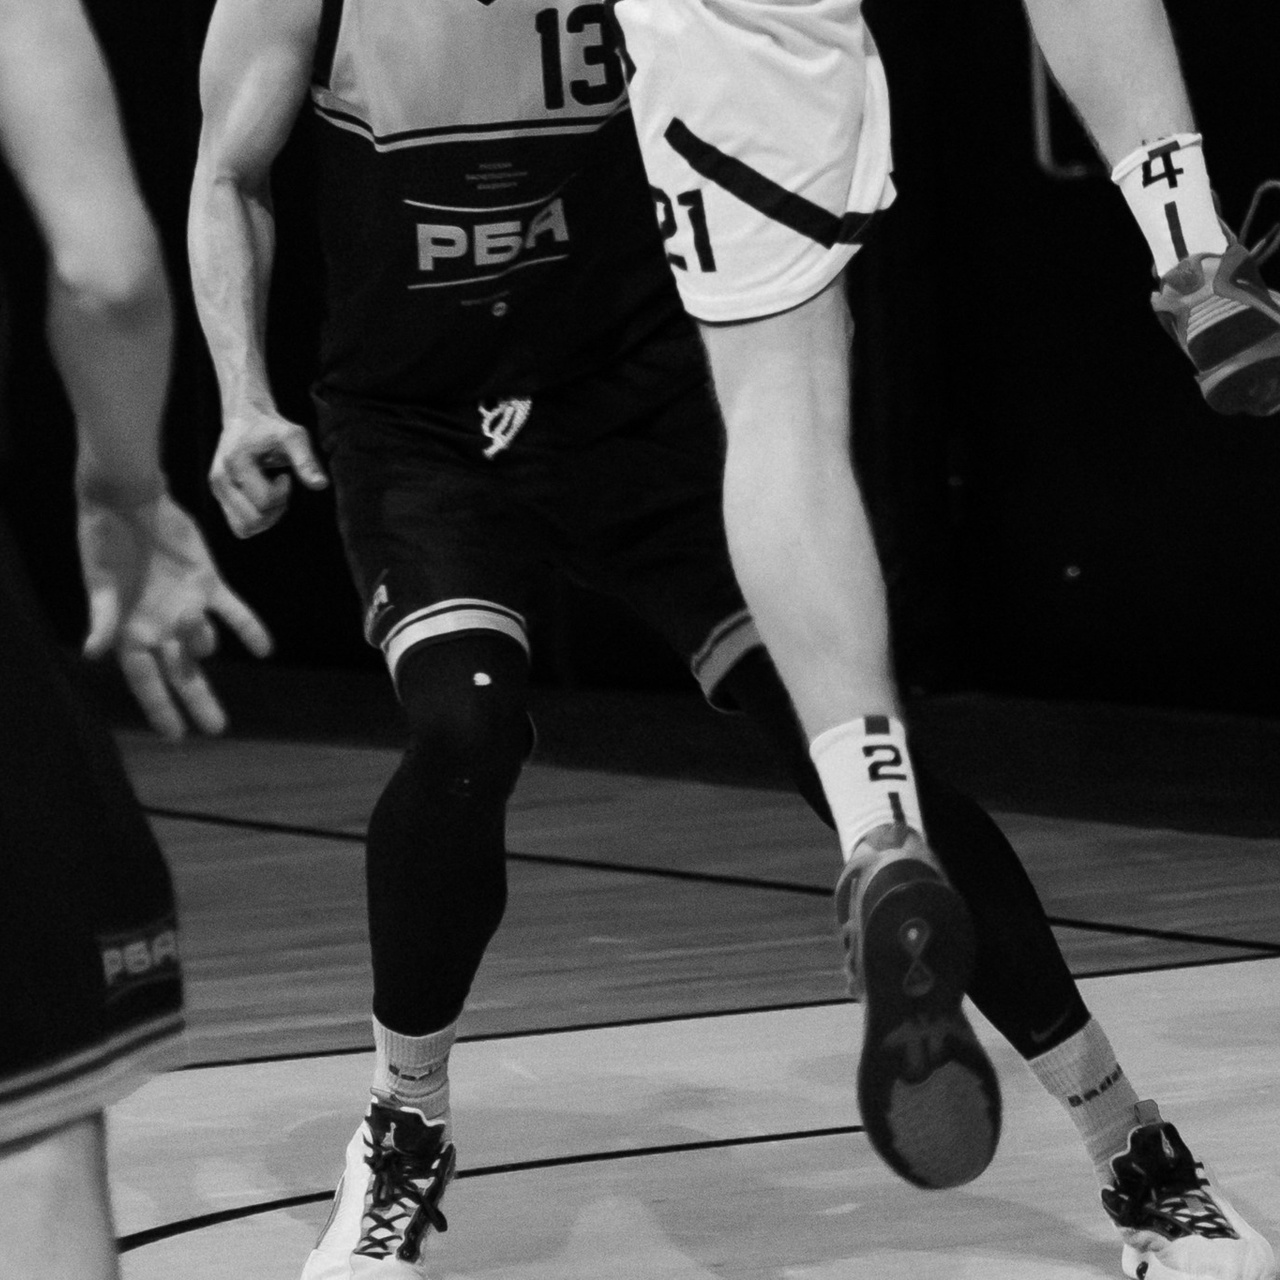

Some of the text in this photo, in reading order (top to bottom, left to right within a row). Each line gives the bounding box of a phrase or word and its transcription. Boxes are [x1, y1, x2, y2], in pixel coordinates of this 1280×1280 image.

[534, 3, 627, 111] 13
[416, 198, 570, 271] РБА
[652, 186, 717, 274] 21
